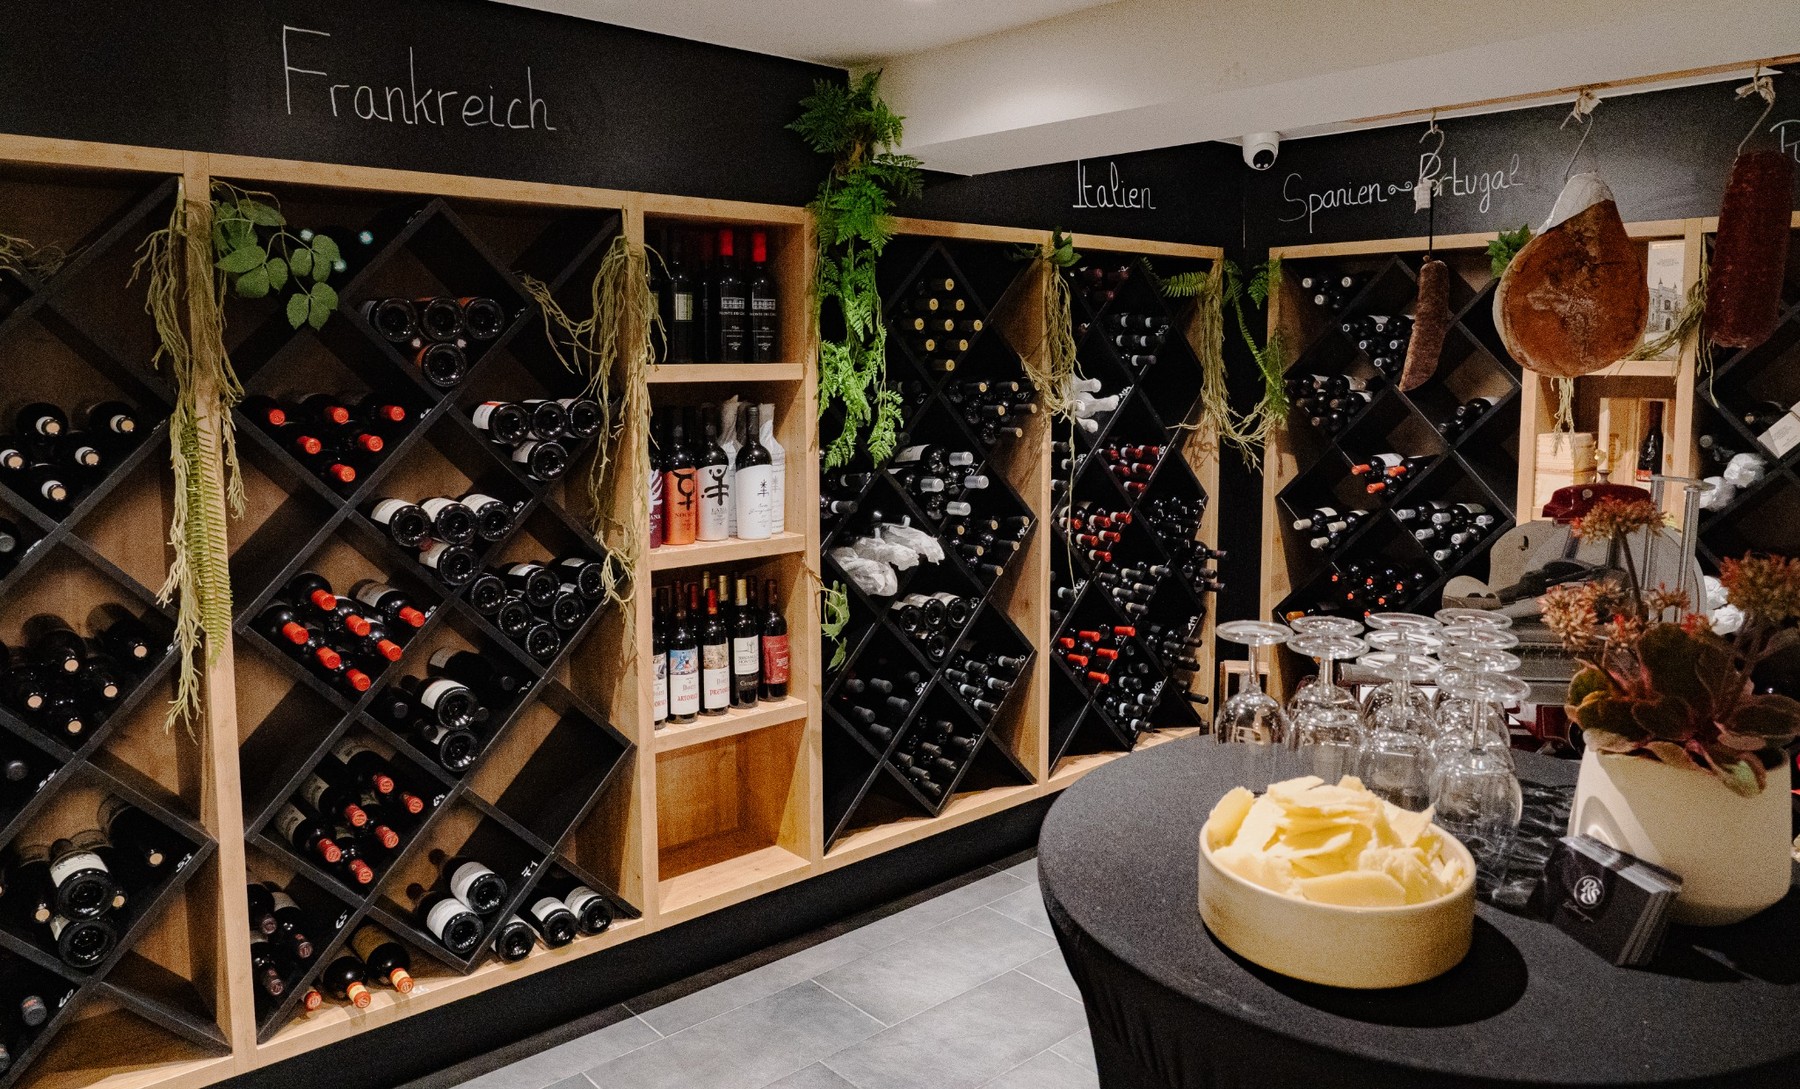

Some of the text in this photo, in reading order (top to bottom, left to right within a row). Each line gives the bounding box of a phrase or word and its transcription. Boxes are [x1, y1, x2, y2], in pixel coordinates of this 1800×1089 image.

[282, 24, 557, 131] Frankreich
[1072, 159, 1157, 210] Italien
[1278, 172, 1387, 234] Spanien
[335, 908, 348, 930] 65
